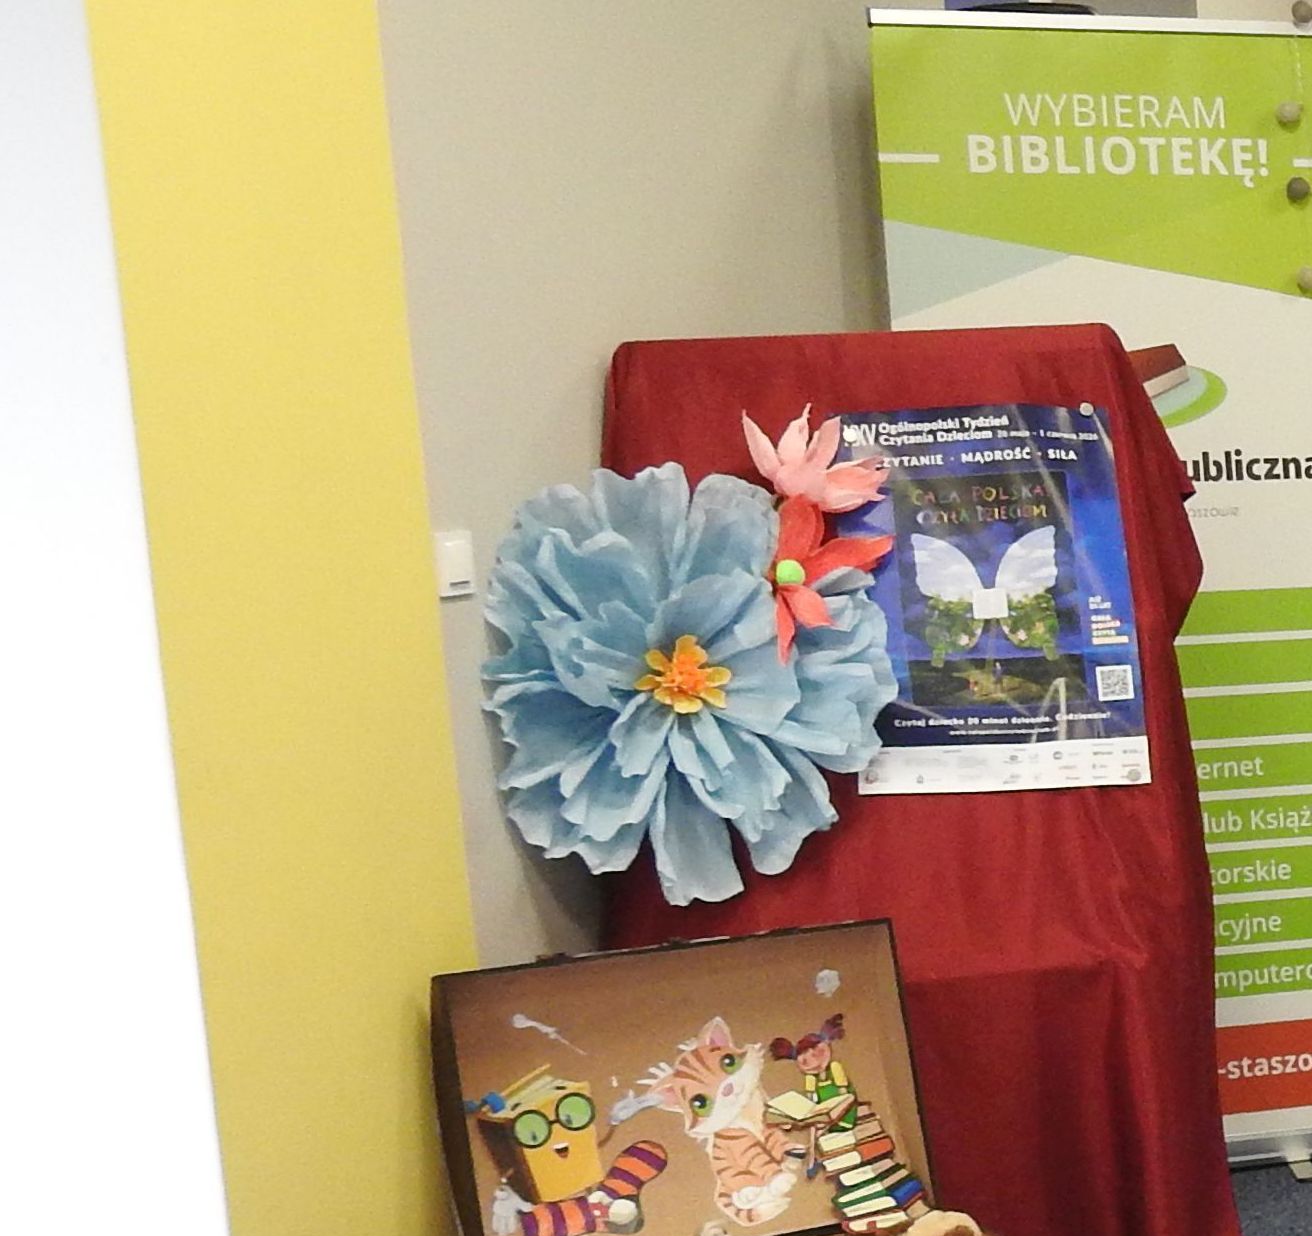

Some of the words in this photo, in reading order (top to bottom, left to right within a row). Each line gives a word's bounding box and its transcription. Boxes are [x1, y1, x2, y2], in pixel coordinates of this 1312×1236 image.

[1003, 92, 1226, 129] WYBIERAM
[966, 133, 1269, 189] BIBLIOTEKĘ!
[879, 430, 935, 447] Czytania
[936, 429, 993, 442] Dzieciom
[876, 453, 945, 469] ZYTANIE
[961, 446, 1032, 464] MĄDROŚĆ
[1047, 448, 1078, 461] SIŁA
[1197, 756, 1265, 780] ernet
[1202, 809, 1243, 834] lub
[1216, 912, 1282, 943] cyjne
